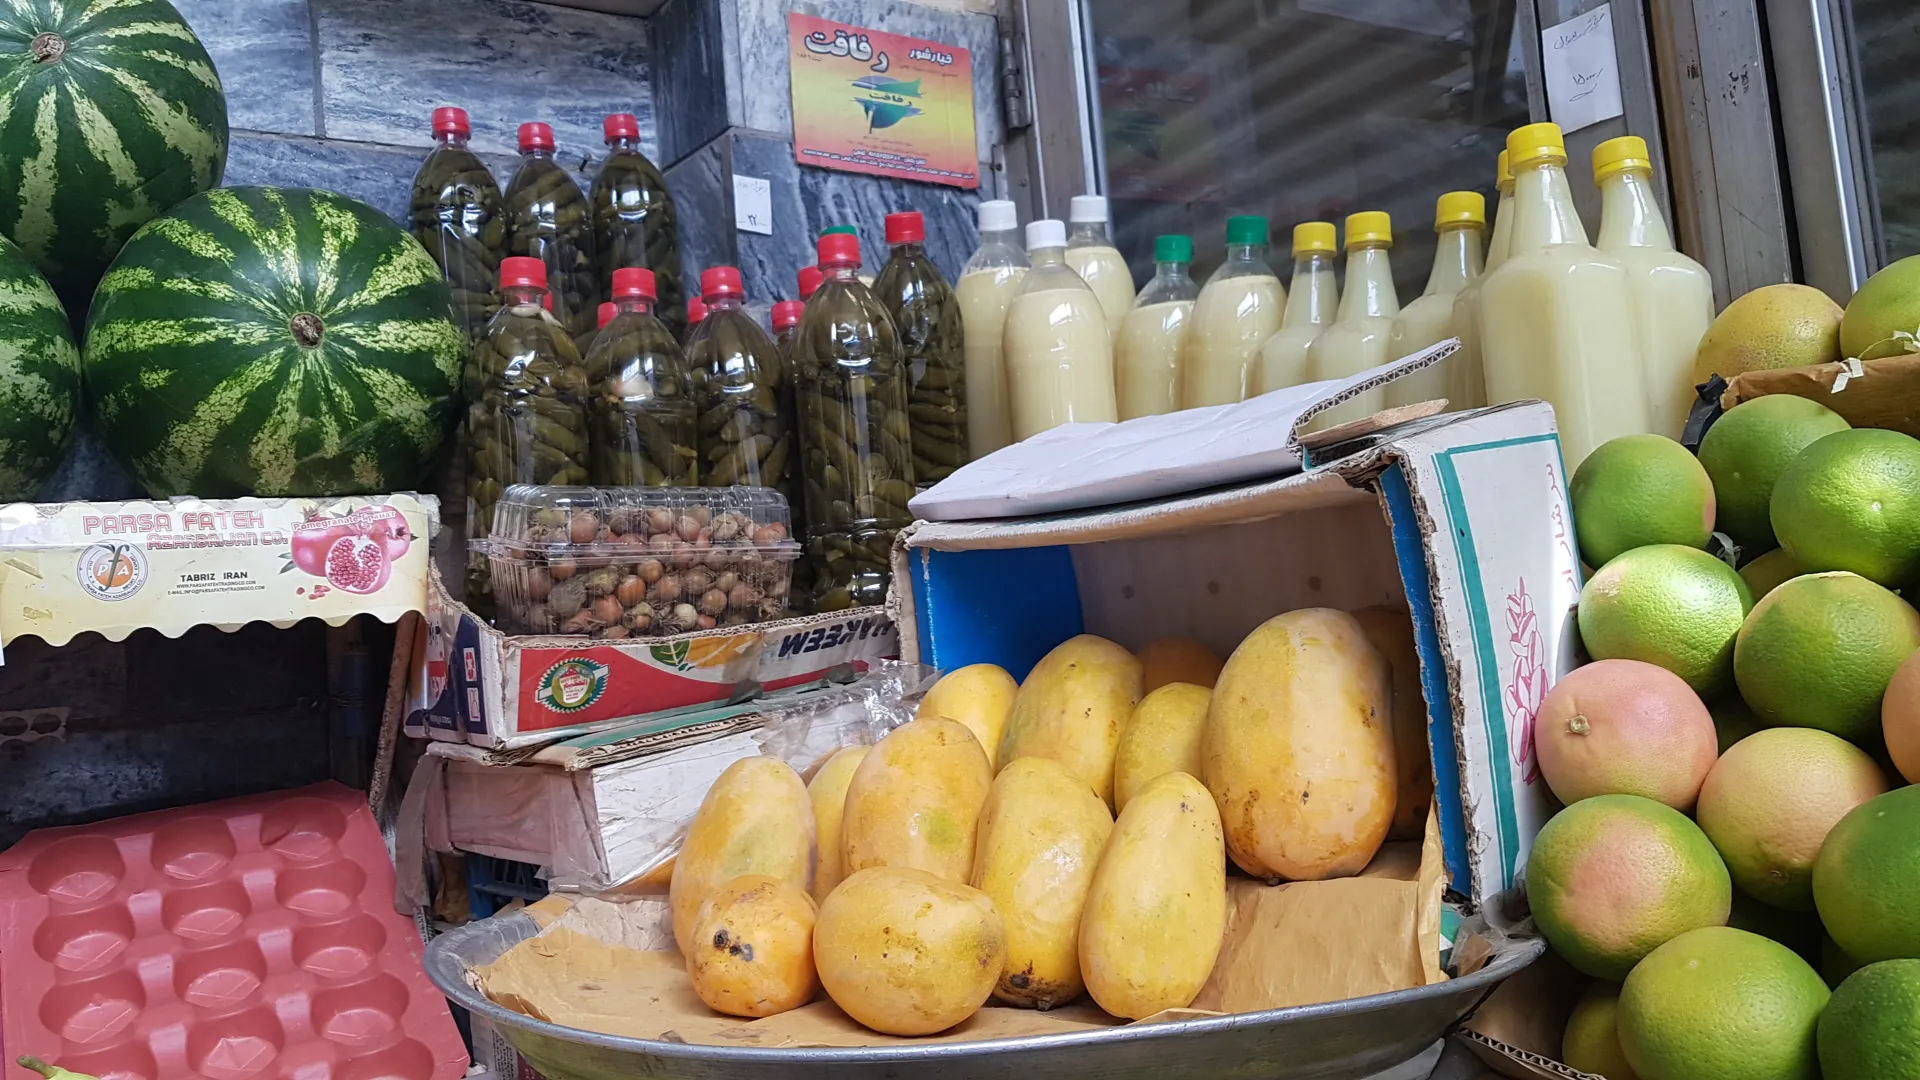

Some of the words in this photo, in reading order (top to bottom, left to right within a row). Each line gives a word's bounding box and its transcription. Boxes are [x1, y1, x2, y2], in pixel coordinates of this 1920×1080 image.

[804, 30, 890, 72] رفاقت
[909, 47, 953, 66] خیارشور
[83, 513, 172, 535] PARSA
[182, 511, 265, 532] FATEH
[147, 531, 258, 550] AZARBAIJAN
[261, 531, 289, 546] CO.
[180, 573, 215, 582] TABRIZ
[223, 571, 248, 580] IRAN
